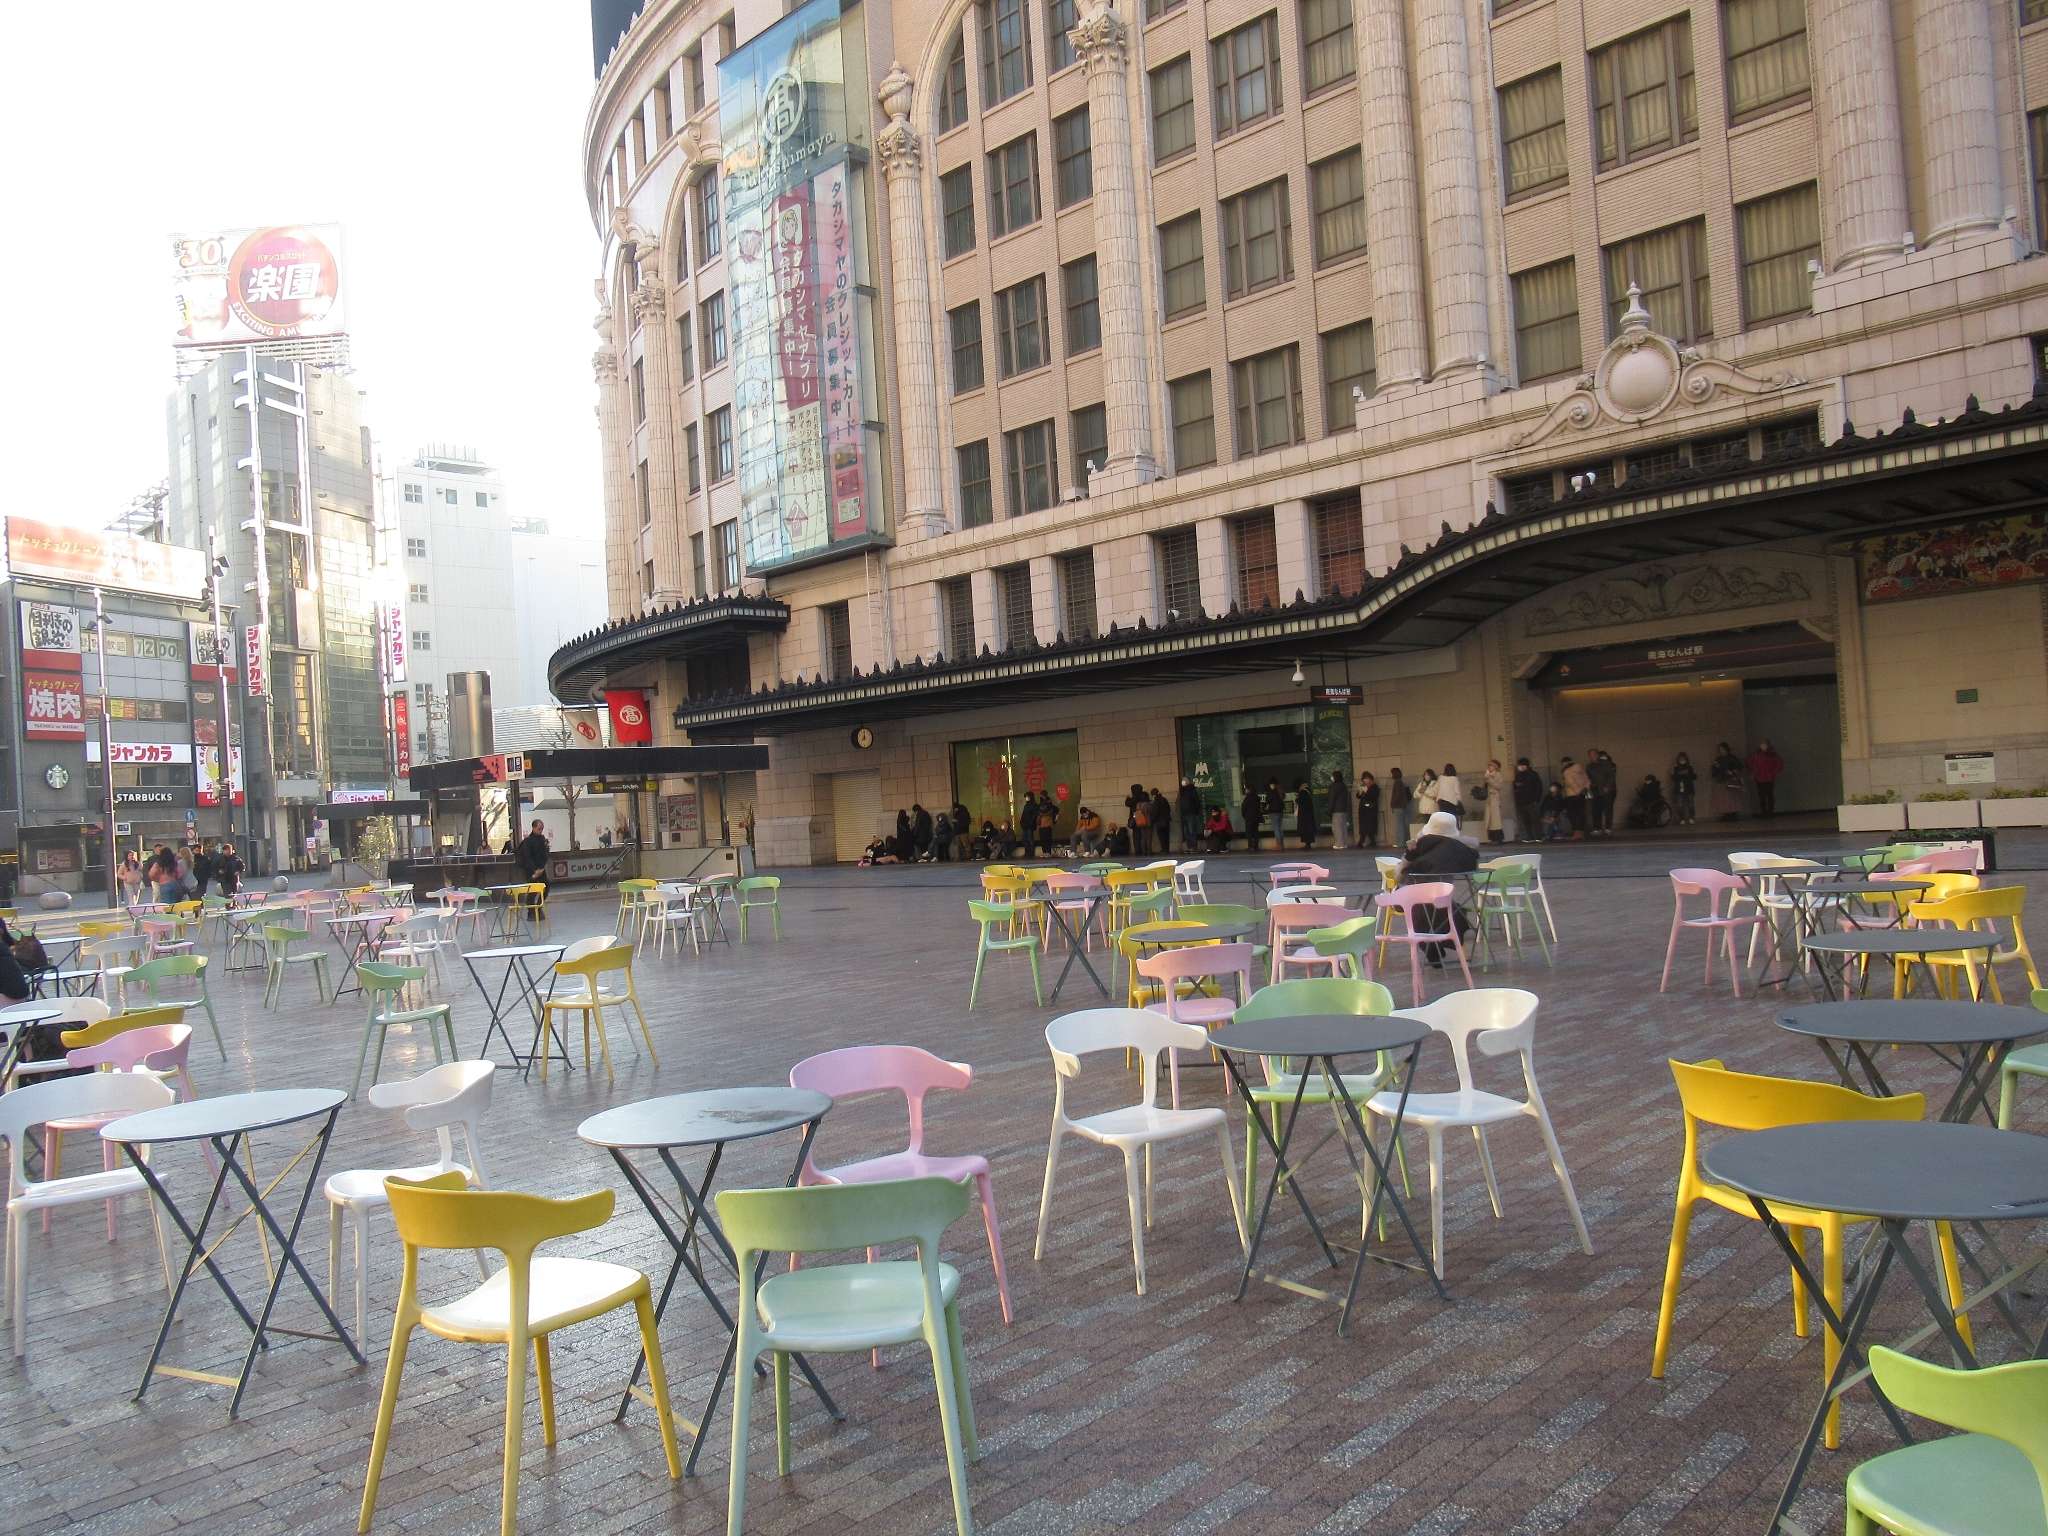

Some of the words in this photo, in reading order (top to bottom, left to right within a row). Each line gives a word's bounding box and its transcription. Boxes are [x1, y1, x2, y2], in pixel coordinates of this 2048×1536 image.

[231, 301, 275, 337] EXCITING
[831, 181, 858, 438] タカシマヤのクレジットカード
[824, 296, 842, 441] 会員募集中!
[391, 607, 404, 666] ジャンカラ
[247, 626, 261, 696] ジャンカラ
[28, 687, 81, 719] 焼肉
[110, 745, 172, 761] ジャンカラ
[116, 792, 173, 802] STARBUCKS
